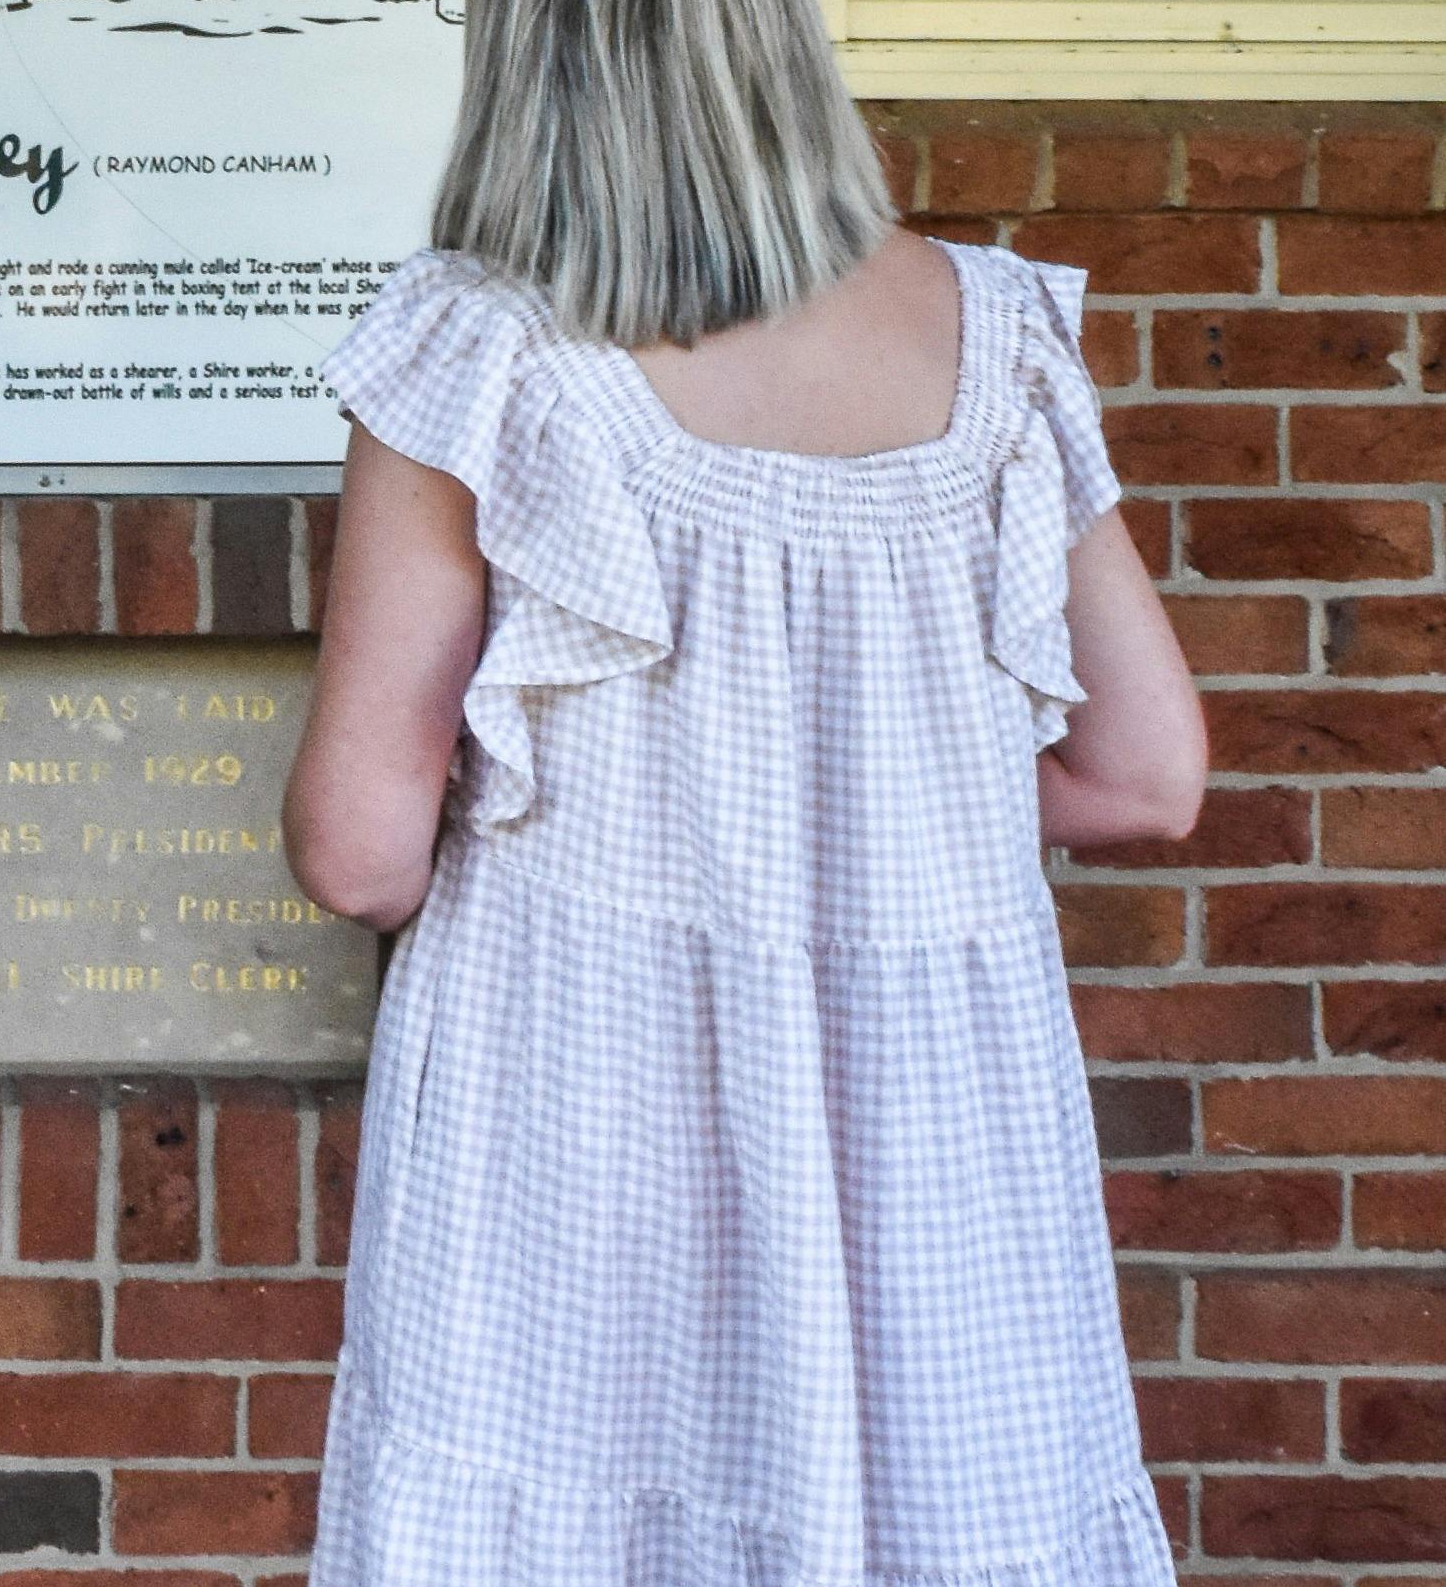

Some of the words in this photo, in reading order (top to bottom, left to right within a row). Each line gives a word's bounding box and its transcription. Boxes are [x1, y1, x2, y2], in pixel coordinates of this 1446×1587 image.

[107, 155, 215, 174] RAYMOND
[222, 154, 317, 173] CANHAM
[28, 257, 52, 276] and
[58, 257, 89, 276] rode
[94, 262, 103, 276] a
[108, 256, 158, 279] cunning
[163, 256, 194, 275] mule
[200, 256, 241, 275] called
[331, 255, 372, 274] whose
[8, 283, 24, 297] on
[30, 283, 46, 297] an
[52, 278, 87, 301] early
[93, 277, 127, 300] fight
[134, 277, 146, 296] in
[152, 277, 175, 296] the
[181, 277, 225, 300] boxing
[231, 277, 260, 296] tent
[267, 276, 282, 295] at
[289, 276, 311, 295] the
[318, 276, 349, 295] local
[356, 276, 384, 295] Sho
[17, 298, 35, 317] He
[42, 298, 79, 317] would
[85, 298, 130, 317] return
[136, 298, 170, 317] later
[176, 298, 188, 317] in
[195, 297, 217, 316] the
[224, 297, 248, 320] day
[254, 297, 289, 316] when
[294, 297, 311, 316] he
[317, 302, 342, 316] was
[6, 361, 29, 380] has
[35, 361, 84, 380] worked
[89, 366, 105, 380] as
[110, 366, 119, 380] a
[189, 365, 198, 379] a
[203, 360, 240, 379] Shire
[305, 365, 314, 379] a
[3, 382, 75, 401] drawn-out
[81, 382, 123, 401] battle
[130, 381, 145, 400] of
[152, 381, 182, 400] wills
[189, 381, 213, 400] and
[220, 386, 228, 400] a
[234, 381, 283, 400] serious
[290, 380, 318, 399] test
[50, 692, 138, 722] WAS
[144, 753, 242, 787] 1929
[177, 893, 340, 926] PRESIDE
